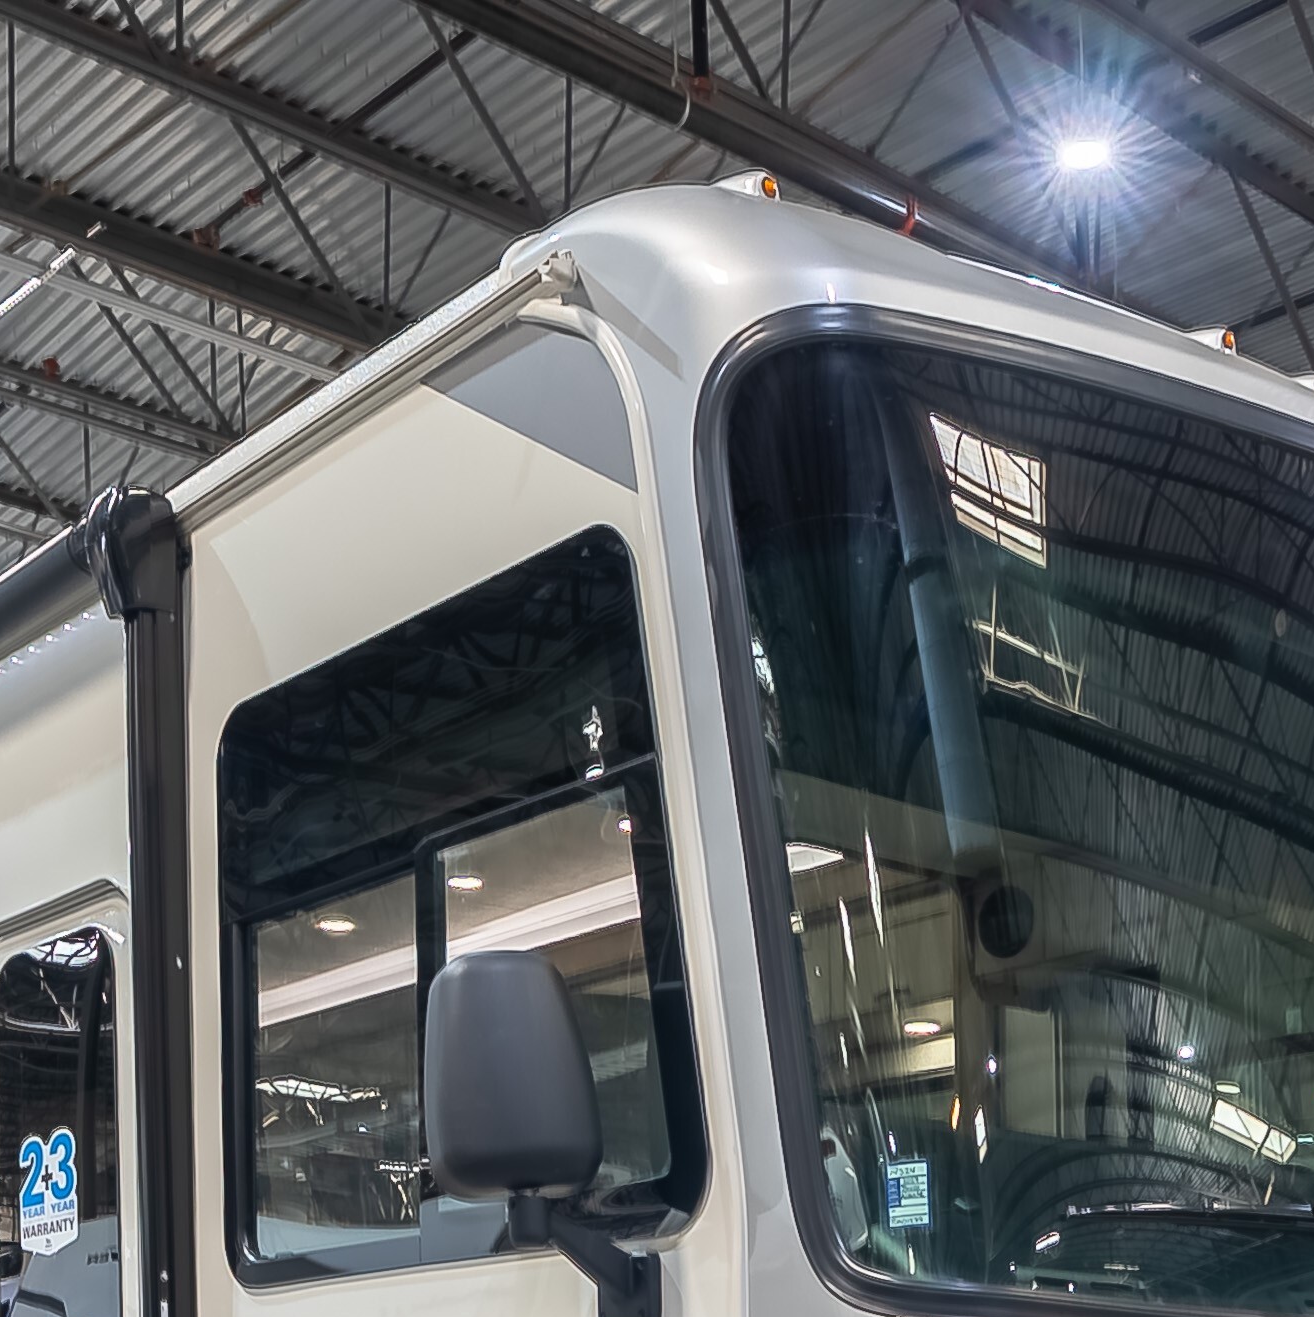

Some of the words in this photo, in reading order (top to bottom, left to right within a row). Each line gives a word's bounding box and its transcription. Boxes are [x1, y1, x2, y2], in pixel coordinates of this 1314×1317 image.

[23, 1206, 45, 1220] YEAR
[50, 1199, 75, 1214] YEAR
[23, 1216, 75, 1240] WARRANTY
